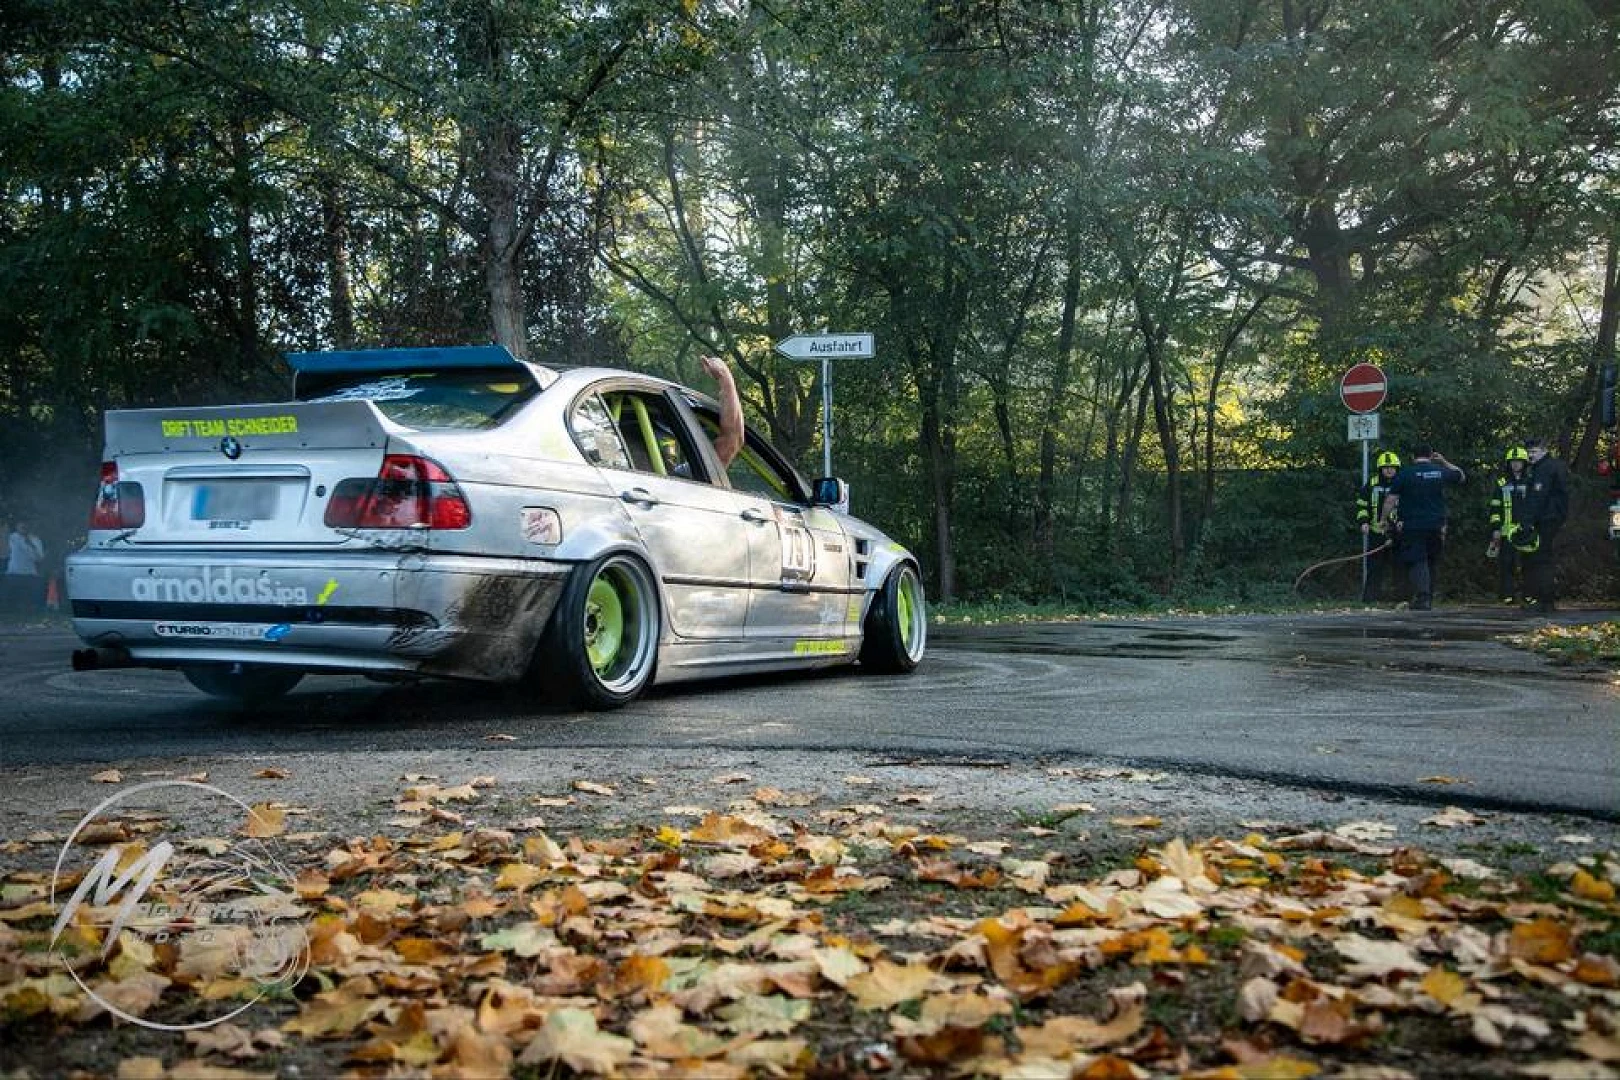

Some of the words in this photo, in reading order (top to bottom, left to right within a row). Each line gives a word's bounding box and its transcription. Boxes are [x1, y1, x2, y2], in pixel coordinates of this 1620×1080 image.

[809, 341, 862, 354] Ausfahrt
[162, 420, 191, 437] DRIFT
[192, 419, 225, 436] TEAM
[227, 415, 298, 436] SCHNEIDER
